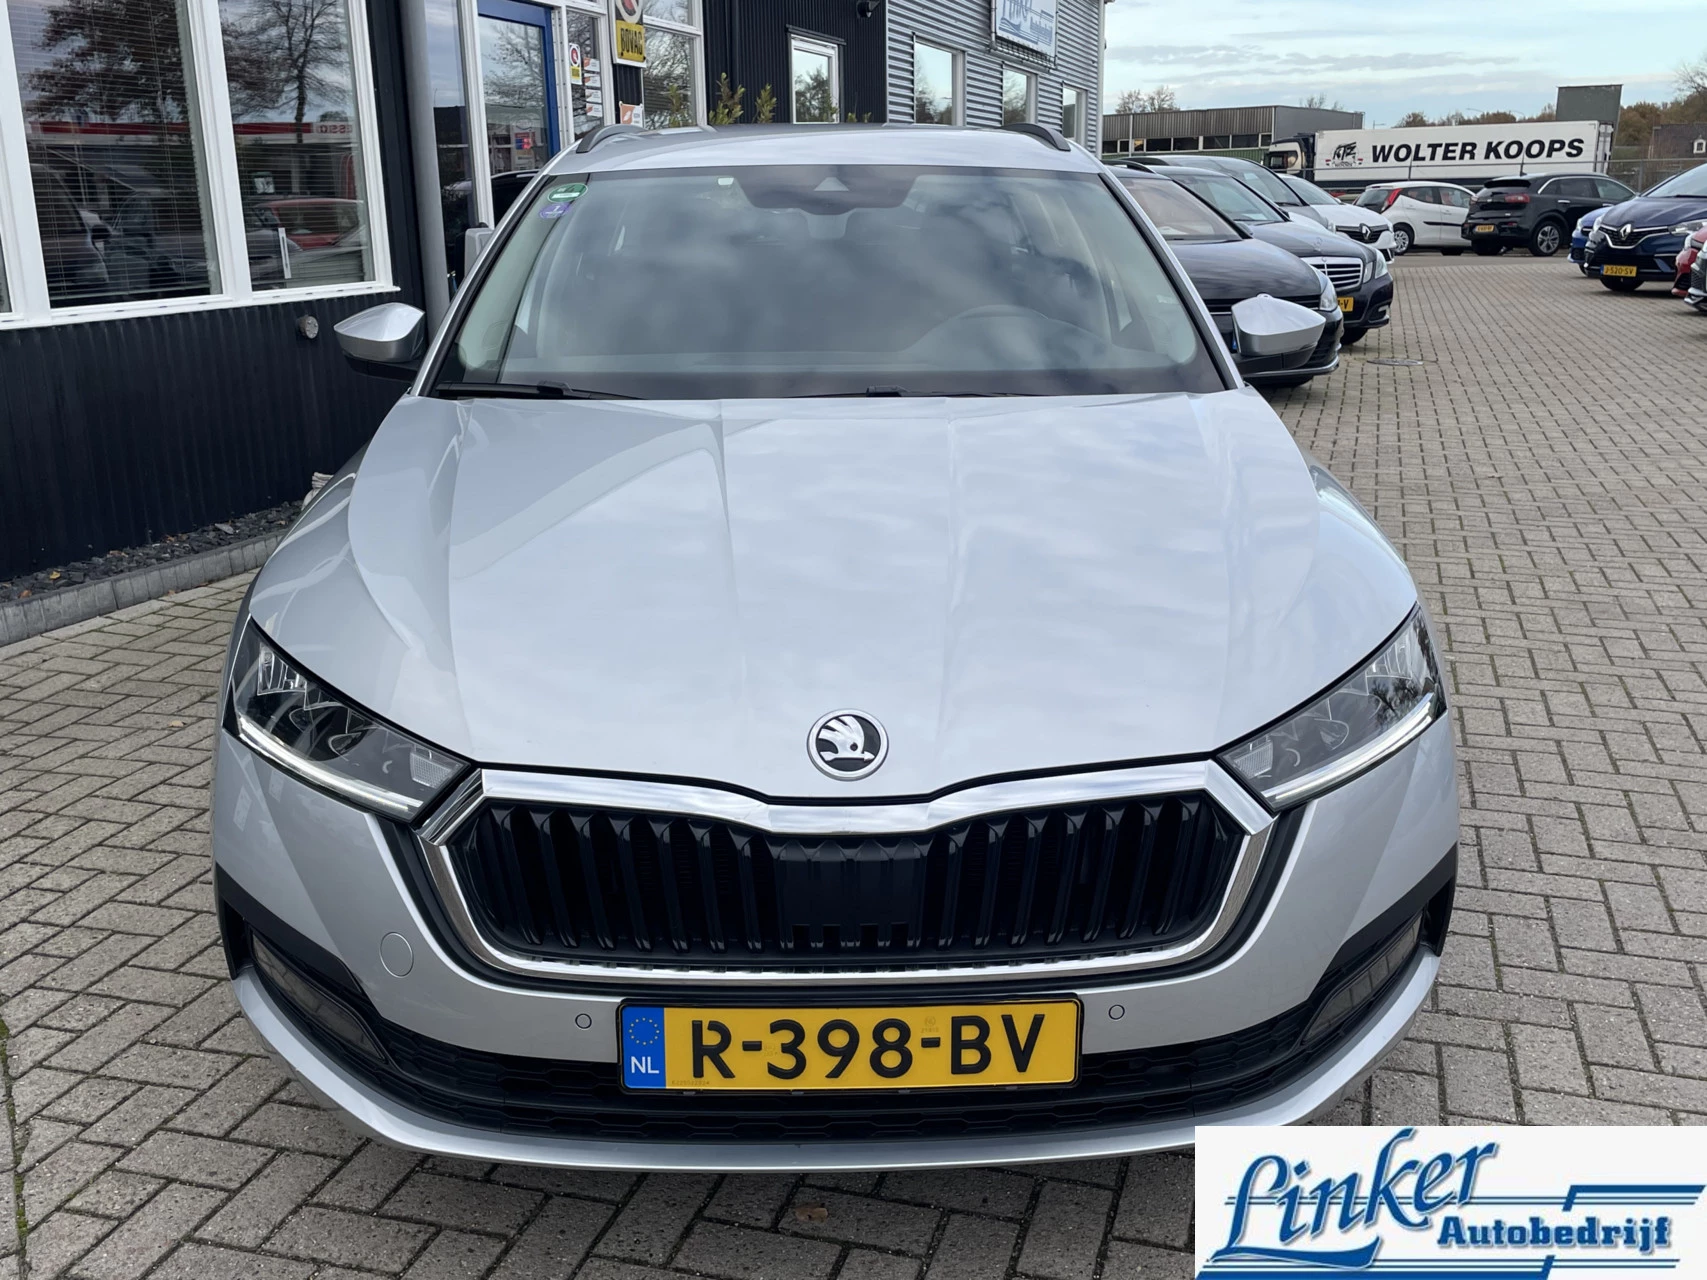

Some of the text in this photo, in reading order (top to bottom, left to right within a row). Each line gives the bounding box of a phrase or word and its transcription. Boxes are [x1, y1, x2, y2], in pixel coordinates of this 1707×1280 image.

[620, 28, 643, 55] BOVAG
[1372, 143, 1476, 163] WOLTER
[1484, 138, 1585, 160] KOOPS
[691, 1014, 1046, 1079] R-398-BV
[631, 1056, 660, 1074] NL
